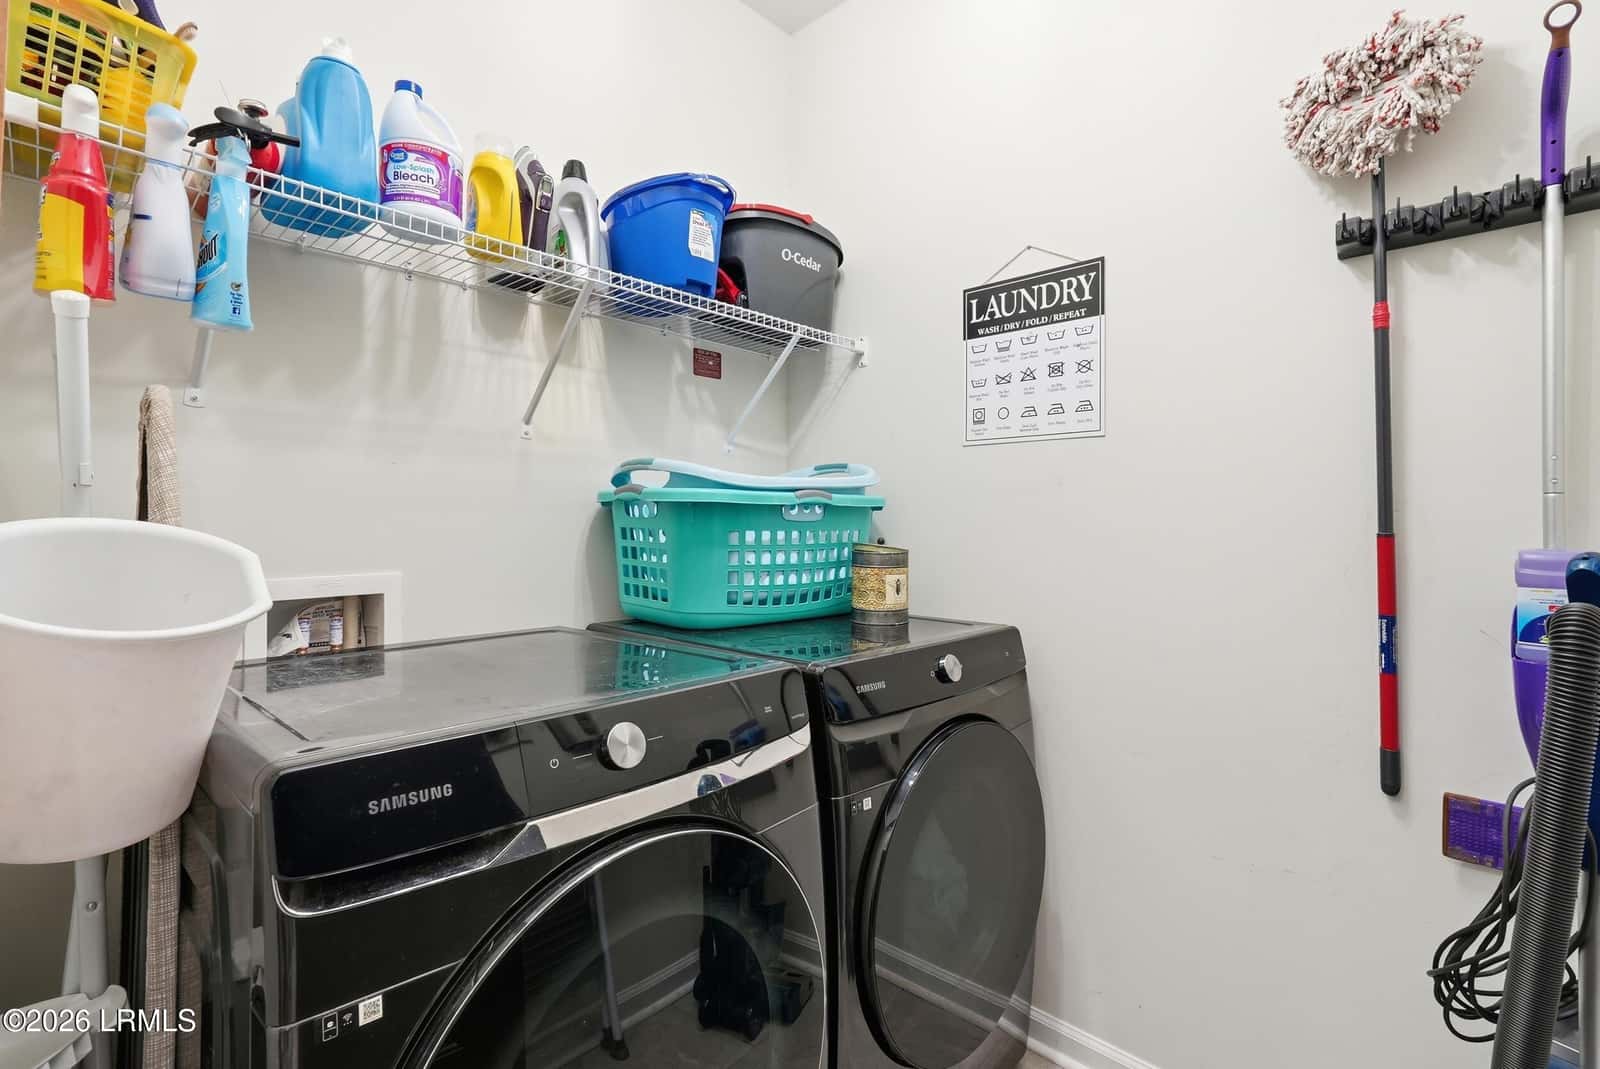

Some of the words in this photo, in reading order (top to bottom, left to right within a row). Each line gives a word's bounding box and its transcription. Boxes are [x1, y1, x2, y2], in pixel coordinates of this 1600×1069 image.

[393, 171, 434, 185] Bleach
[781, 247, 822, 273] O-Cedar
[969, 271, 1097, 324] LAUNDRY
[977, 325, 999, 336] WASH
[1004, 322, 1021, 332] DRY
[1025, 316, 1048, 327] FOLD
[1053, 308, 1087, 322] REPEAT
[855, 679, 886, 695] SAMSUNG
[367, 783, 454, 816] SAMSUNG
